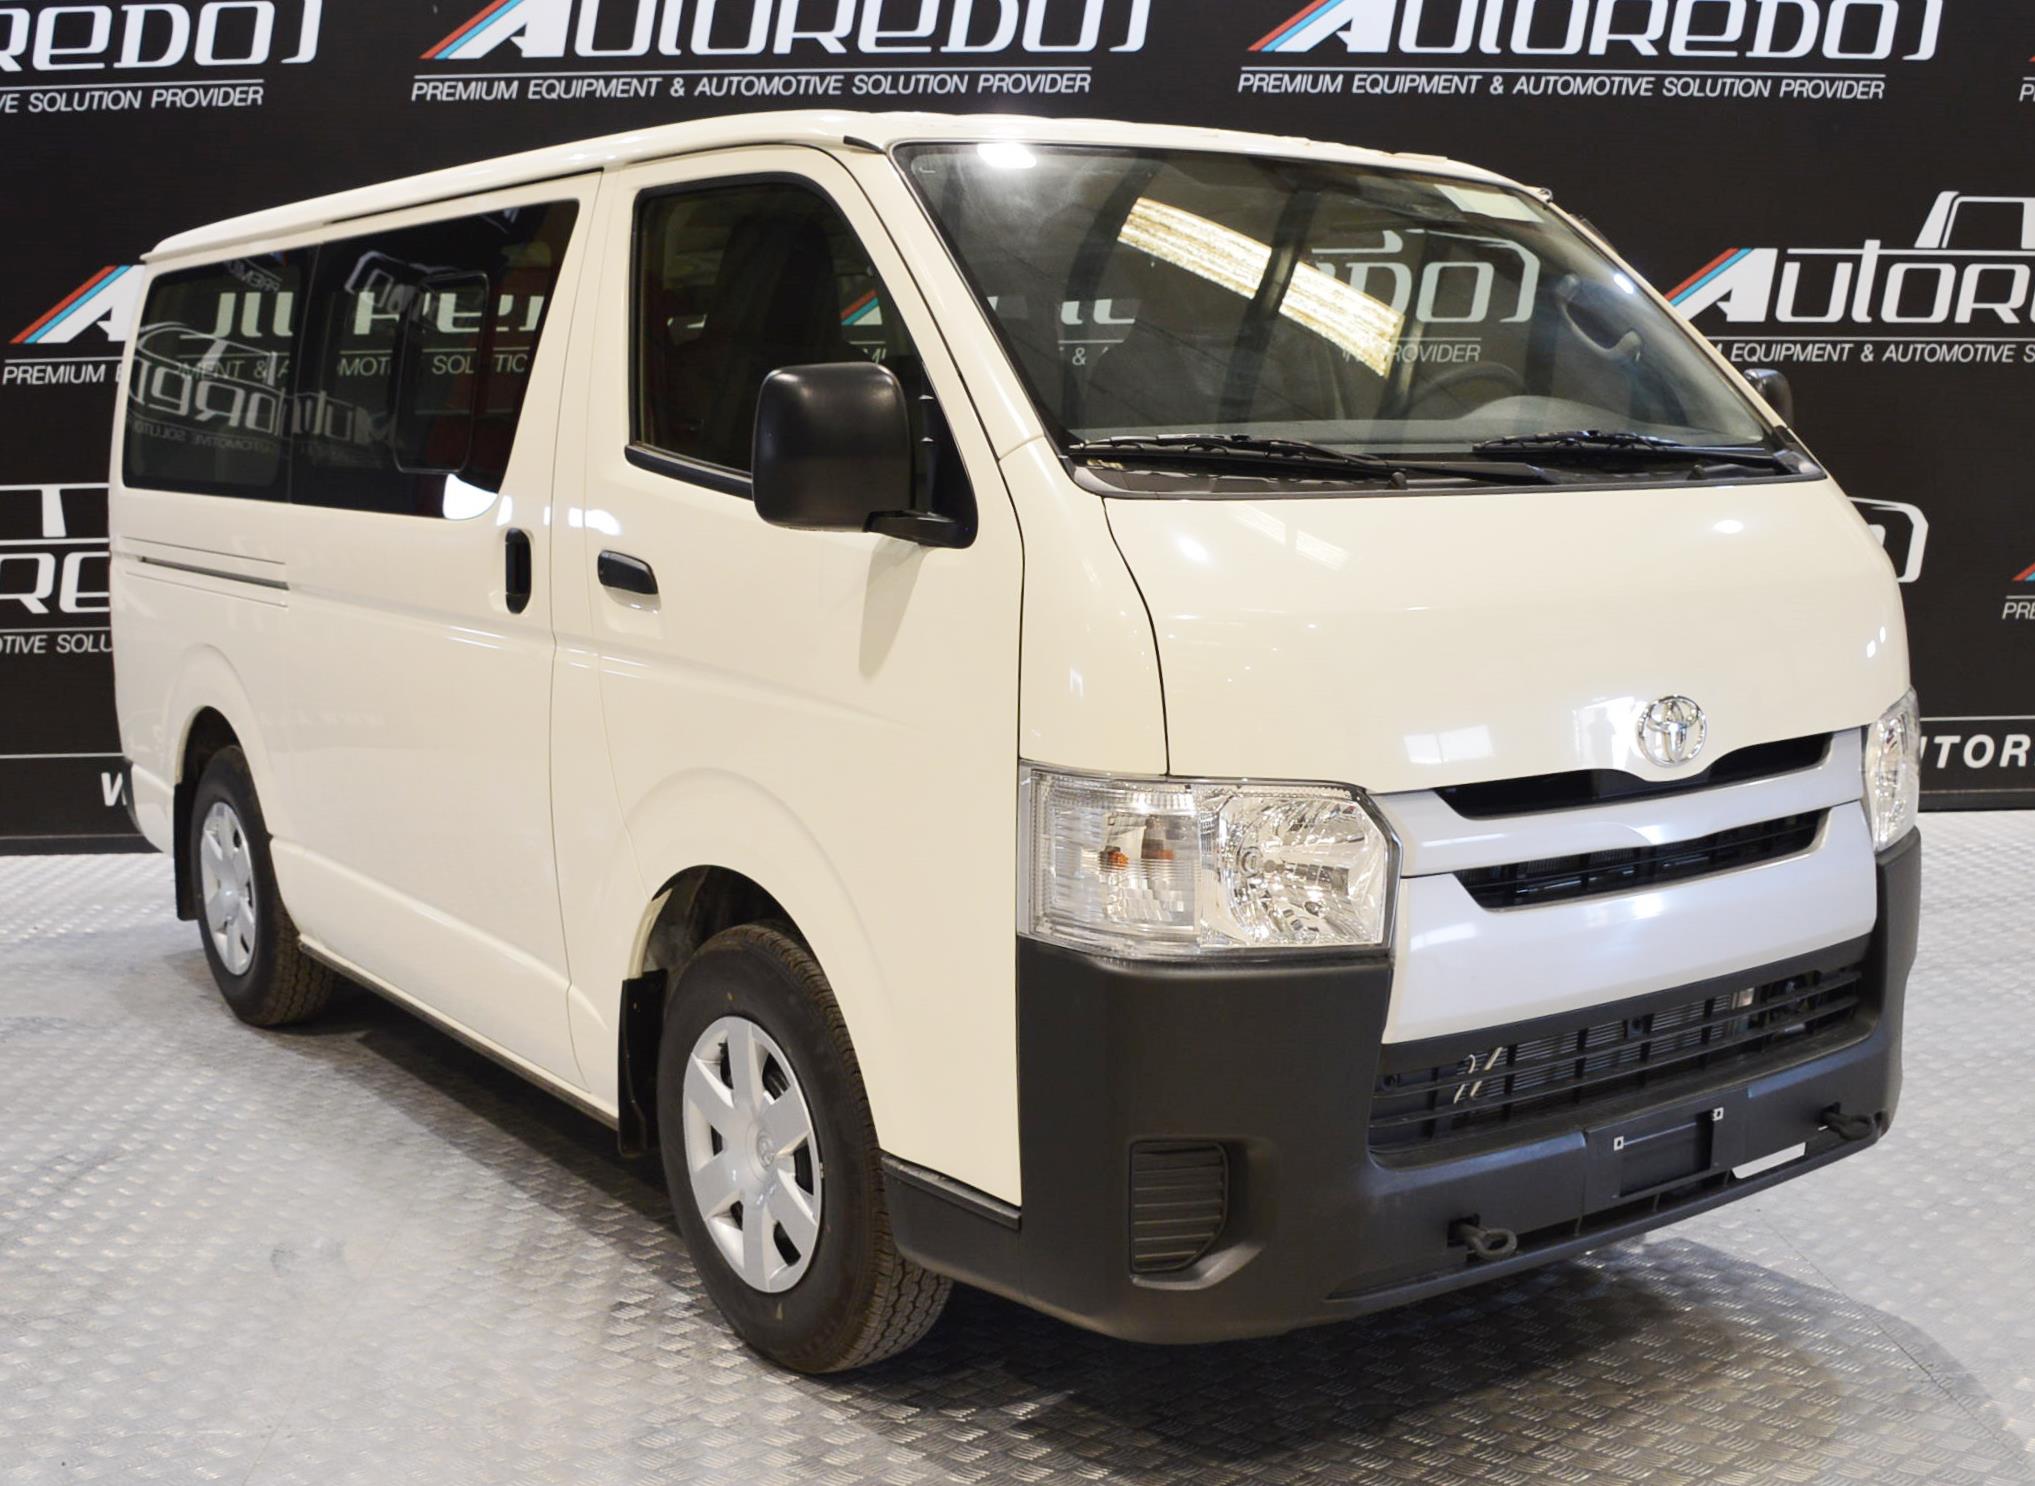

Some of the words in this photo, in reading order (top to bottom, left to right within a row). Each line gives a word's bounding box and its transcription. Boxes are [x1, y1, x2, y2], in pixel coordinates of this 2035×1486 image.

[28, 90, 142, 113] SOLUTION
[151, 86, 264, 109] PROVIDER
[411, 80, 519, 102] PREMIUM
[528, 77, 662, 99] EQUIPMENT
[670, 78, 685, 97] &
[694, 75, 844, 97] AUTOMOTIVE
[852, 74, 968, 95] SOLUTION
[977, 73, 1091, 94] PROVIDER
[1238, 73, 1344, 93] PREMIUM
[1352, 74, 1482, 95] EQUIPMENT
[1490, 76, 1504, 95] &
[1513, 76, 1655, 97] AUTOMOTIVE
[1662, 77, 1771, 98] SOLUTION
[1779, 79, 1885, 100] PROVIDER
[1665, 239, 2035, 324] AutoR
[1072, 347, 1086, 365] &
[1730, 343, 1853, 362] EQUIPMENT
[1861, 344, 1874, 362] &
[1882, 344, 2014, 363] AUTOMOTIVE
[2, 364, 106, 385] PREMIUM
[0, 635, 47, 654] TIVE
[1920, 733, 2035, 769] TOR
